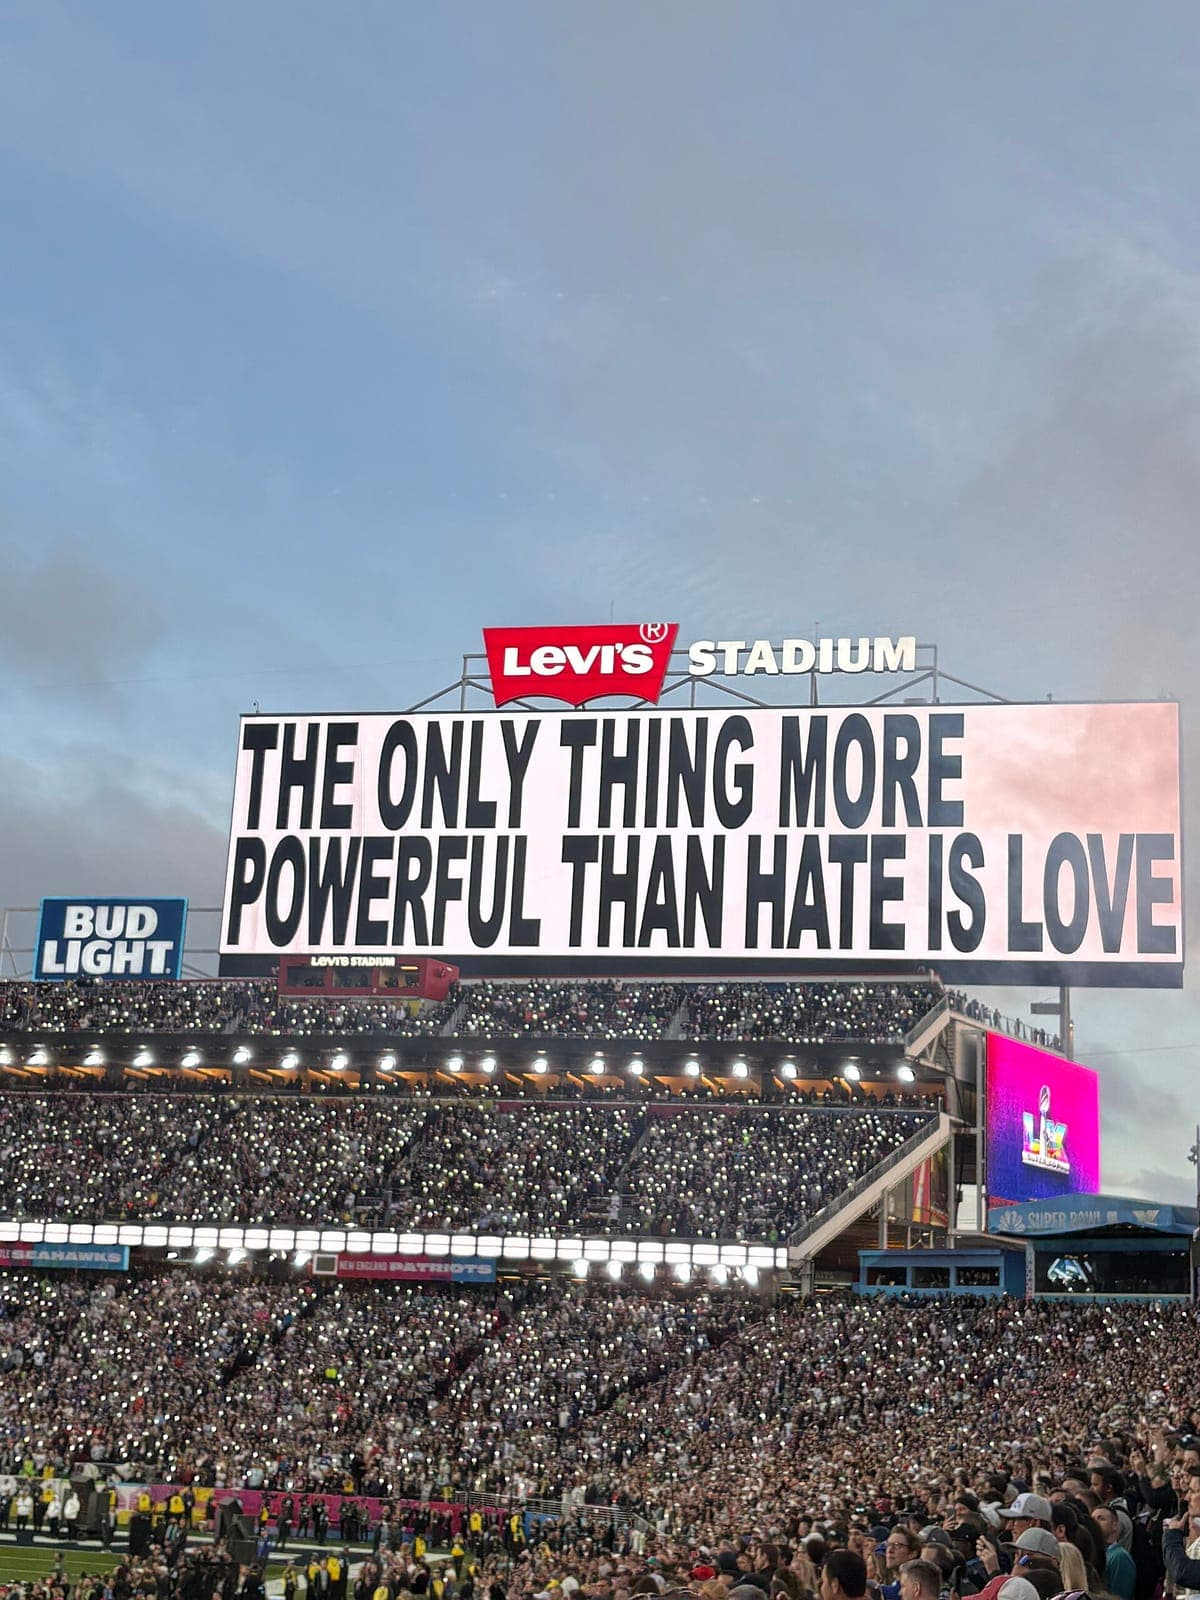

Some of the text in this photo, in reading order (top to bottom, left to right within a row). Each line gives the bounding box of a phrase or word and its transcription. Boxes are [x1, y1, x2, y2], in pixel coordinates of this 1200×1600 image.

[687, 637, 917, 676] STADIUM
[242, 713, 964, 831] THE ONLY THING MORE
[227, 832, 1177, 955] POWERFUL THAN HATE IS LOVE
[63, 905, 158, 938] BUD
[350, 956, 395, 967] STADIUM
[1028, 1210, 1067, 1228] SUPER
[11, 1249, 121, 1263] SEAHAWKS
[389, 1262, 492, 1274] PATRIOTS
